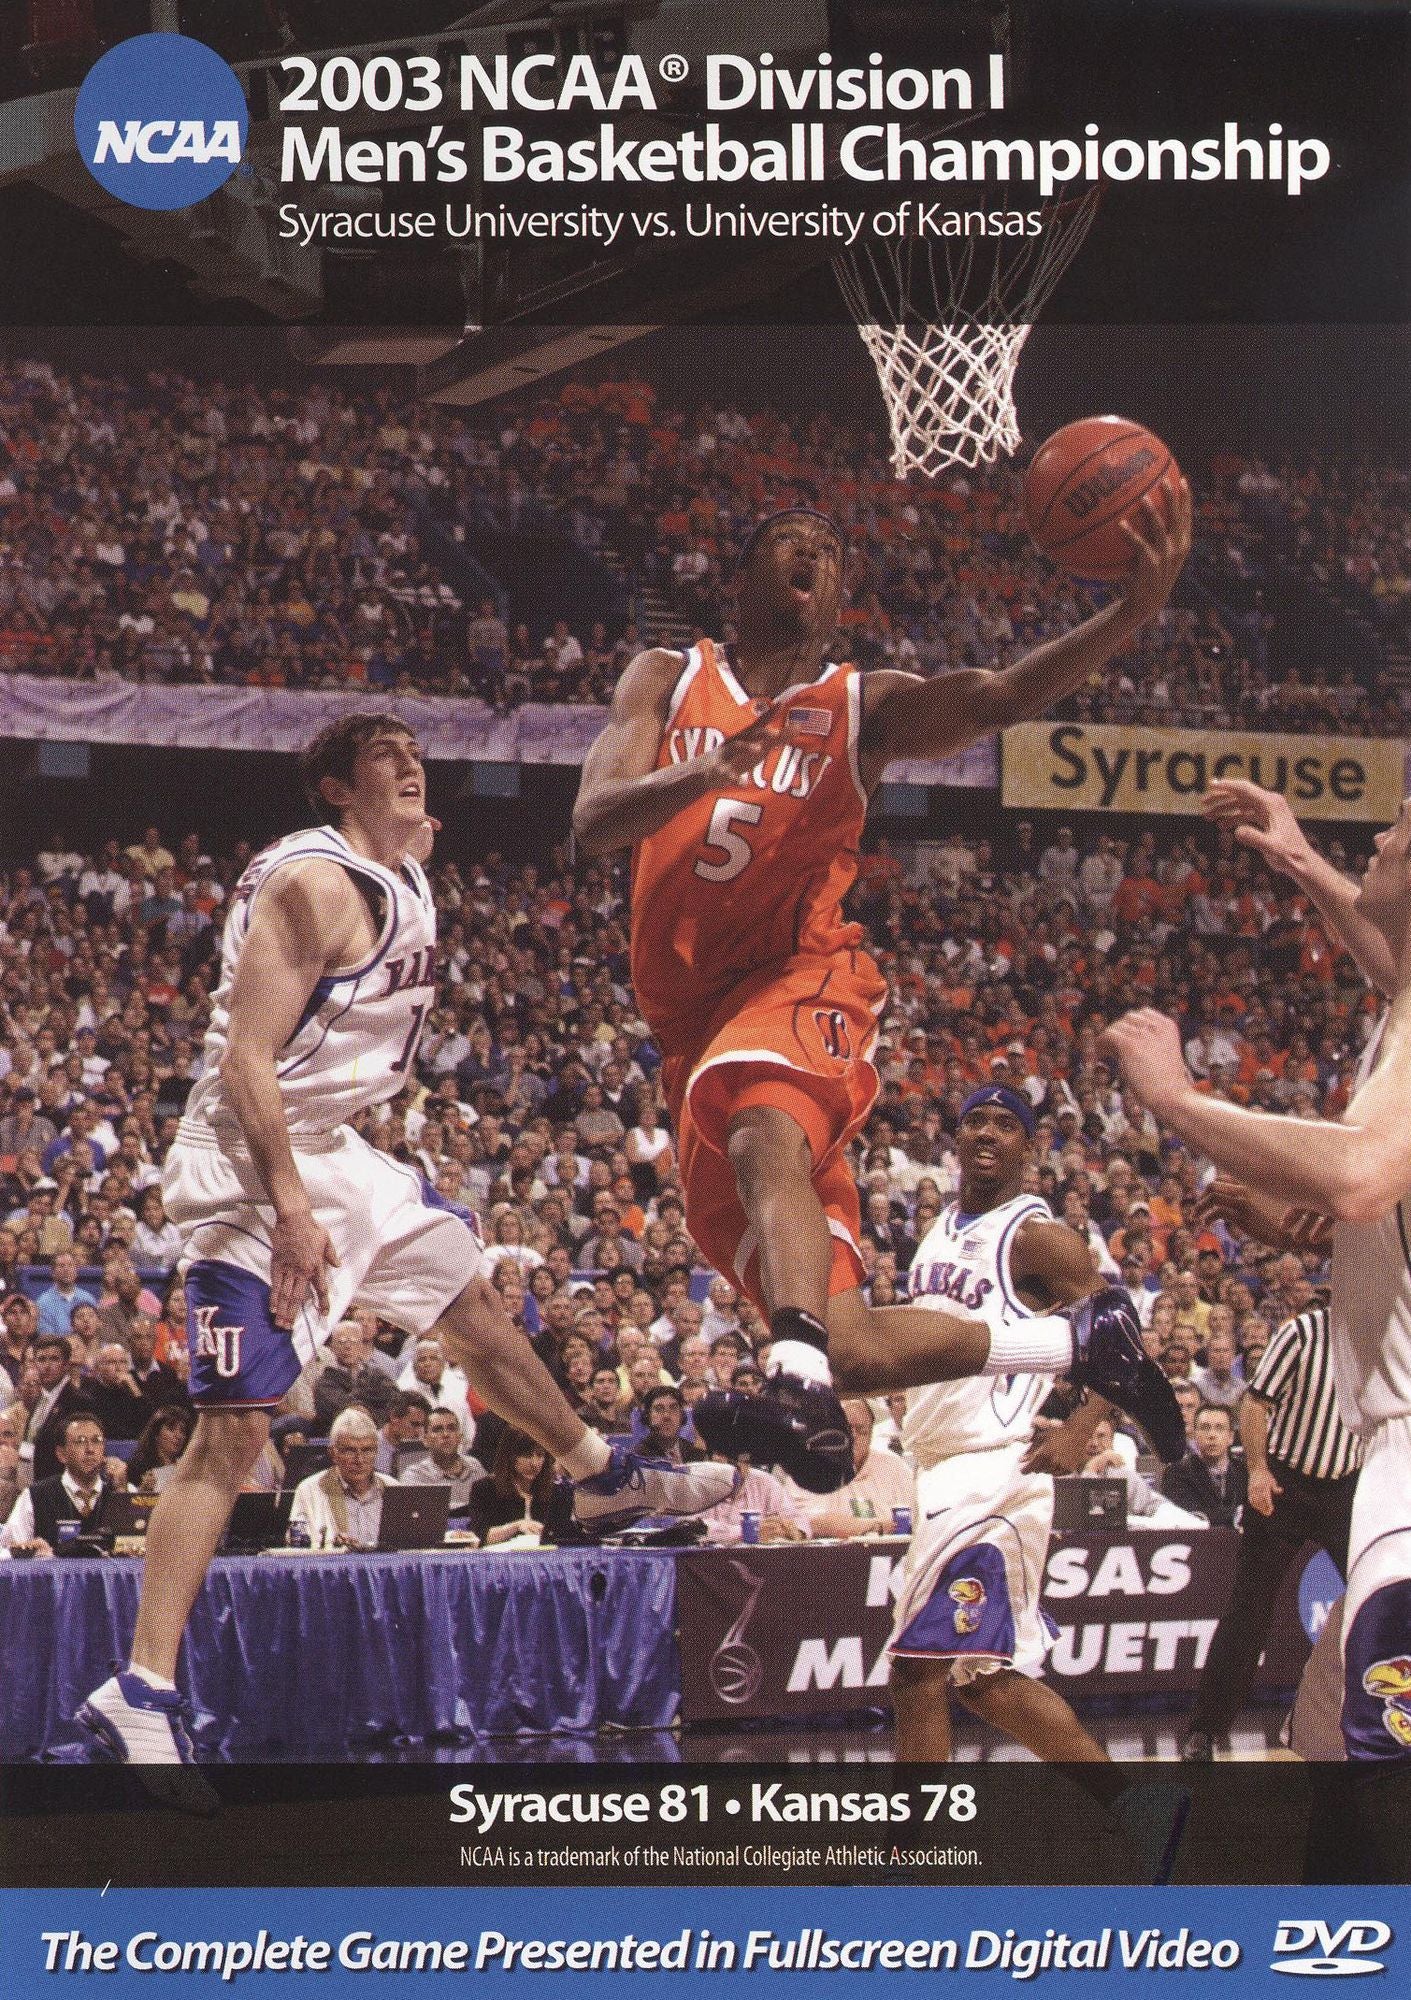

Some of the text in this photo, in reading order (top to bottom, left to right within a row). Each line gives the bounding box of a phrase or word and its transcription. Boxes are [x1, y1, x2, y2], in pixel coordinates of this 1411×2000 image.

[1048, 725, 1366, 808] Syracuse
[693, 797, 763, 883] 5
[193, 1305, 245, 1378] KU
[865, 1545, 1192, 1608] KSAS
